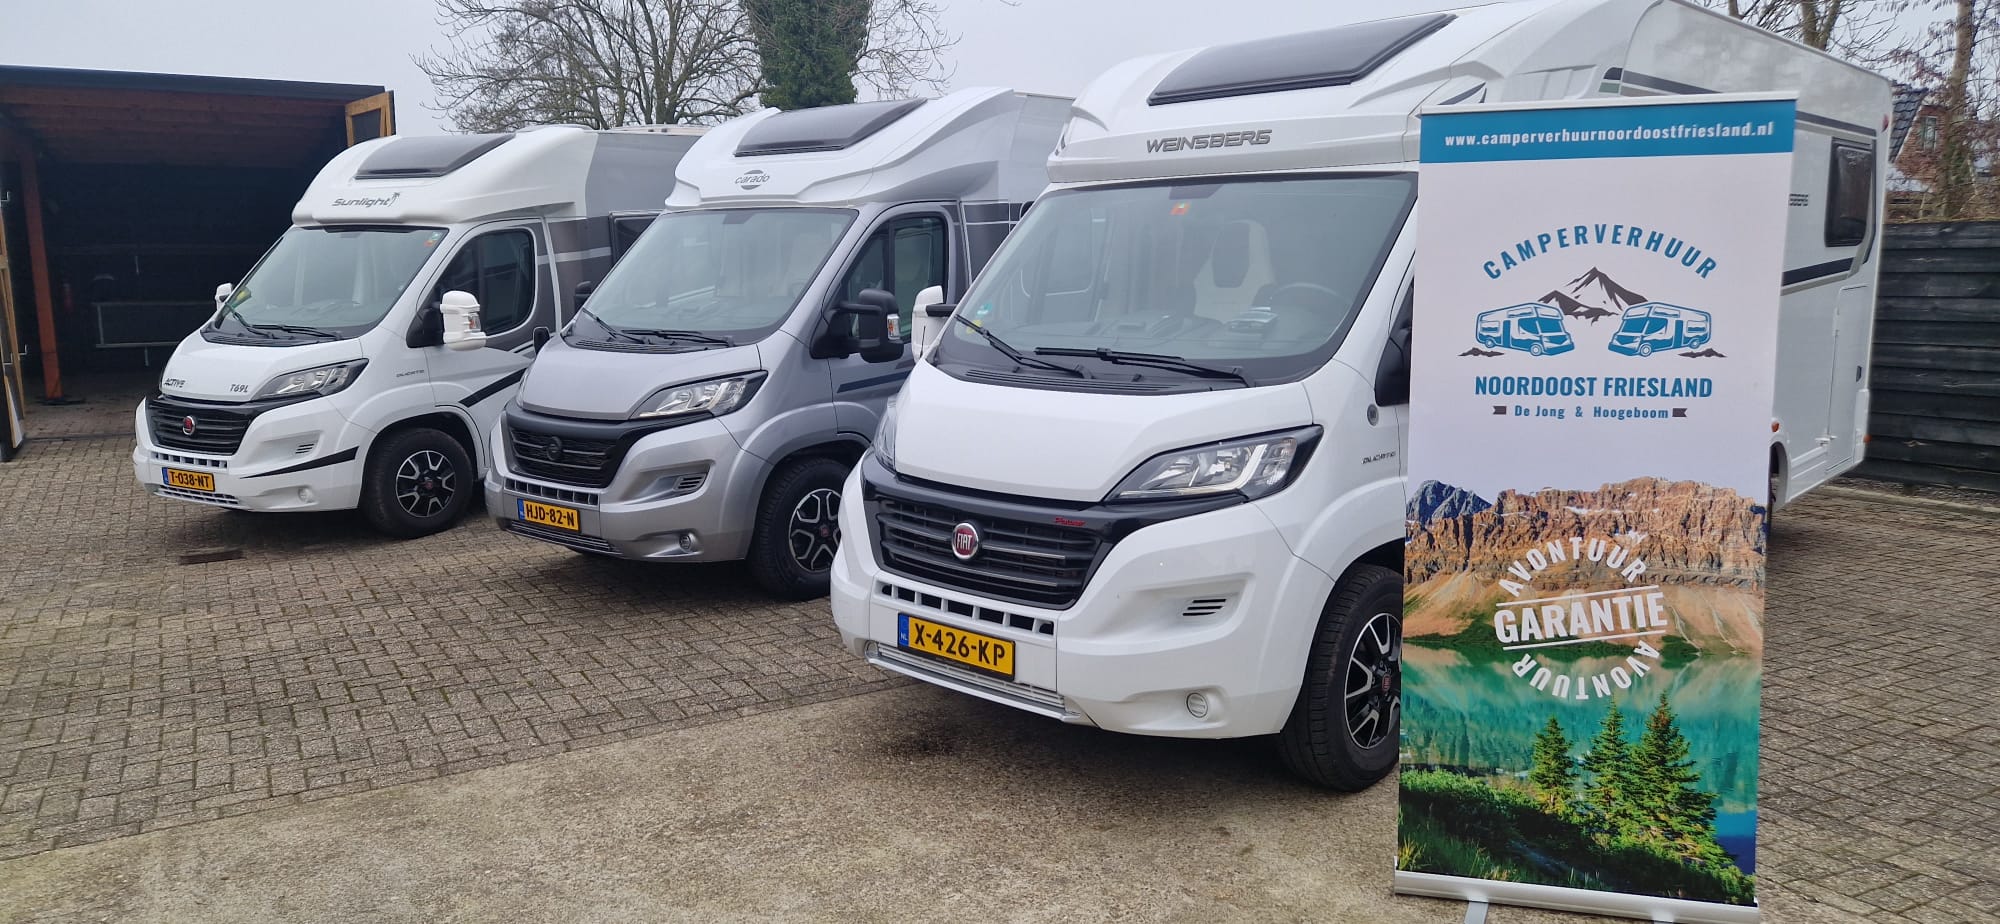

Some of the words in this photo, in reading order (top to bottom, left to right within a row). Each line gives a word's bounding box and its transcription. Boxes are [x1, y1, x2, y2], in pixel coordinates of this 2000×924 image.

[1146, 129, 1273, 153] WEINSBERG
[1444, 121, 1775, 147] www.camperverhuurnoordoostfriesland.nl
[735, 174, 770, 184] carado
[332, 197, 391, 208] Sunlight
[1483, 223, 1717, 280] CAMPERVERHUUR
[230, 384, 249, 393] T69L
[1475, 376, 1597, 397] NOORDOOST
[1603, 377, 1713, 398] FRIESLAND
[1514, 405, 1530, 417] De
[1535, 405, 1566, 419] Jong
[1575, 406, 1583, 418] &
[1593, 406, 1669, 420] Hoogeboom
[169, 471, 210, 488] T-038-NT
[525, 503, 575, 527] HJD-82-N
[956, 532, 973, 550] FIAT
[1498, 537, 1647, 598] AVONTUUR
[1493, 592, 1668, 644] GARANTIE
[900, 632, 908, 641] NL
[914, 622, 1006, 666] X-426-KP
[1512, 640, 1660, 700] AVONTUUR
